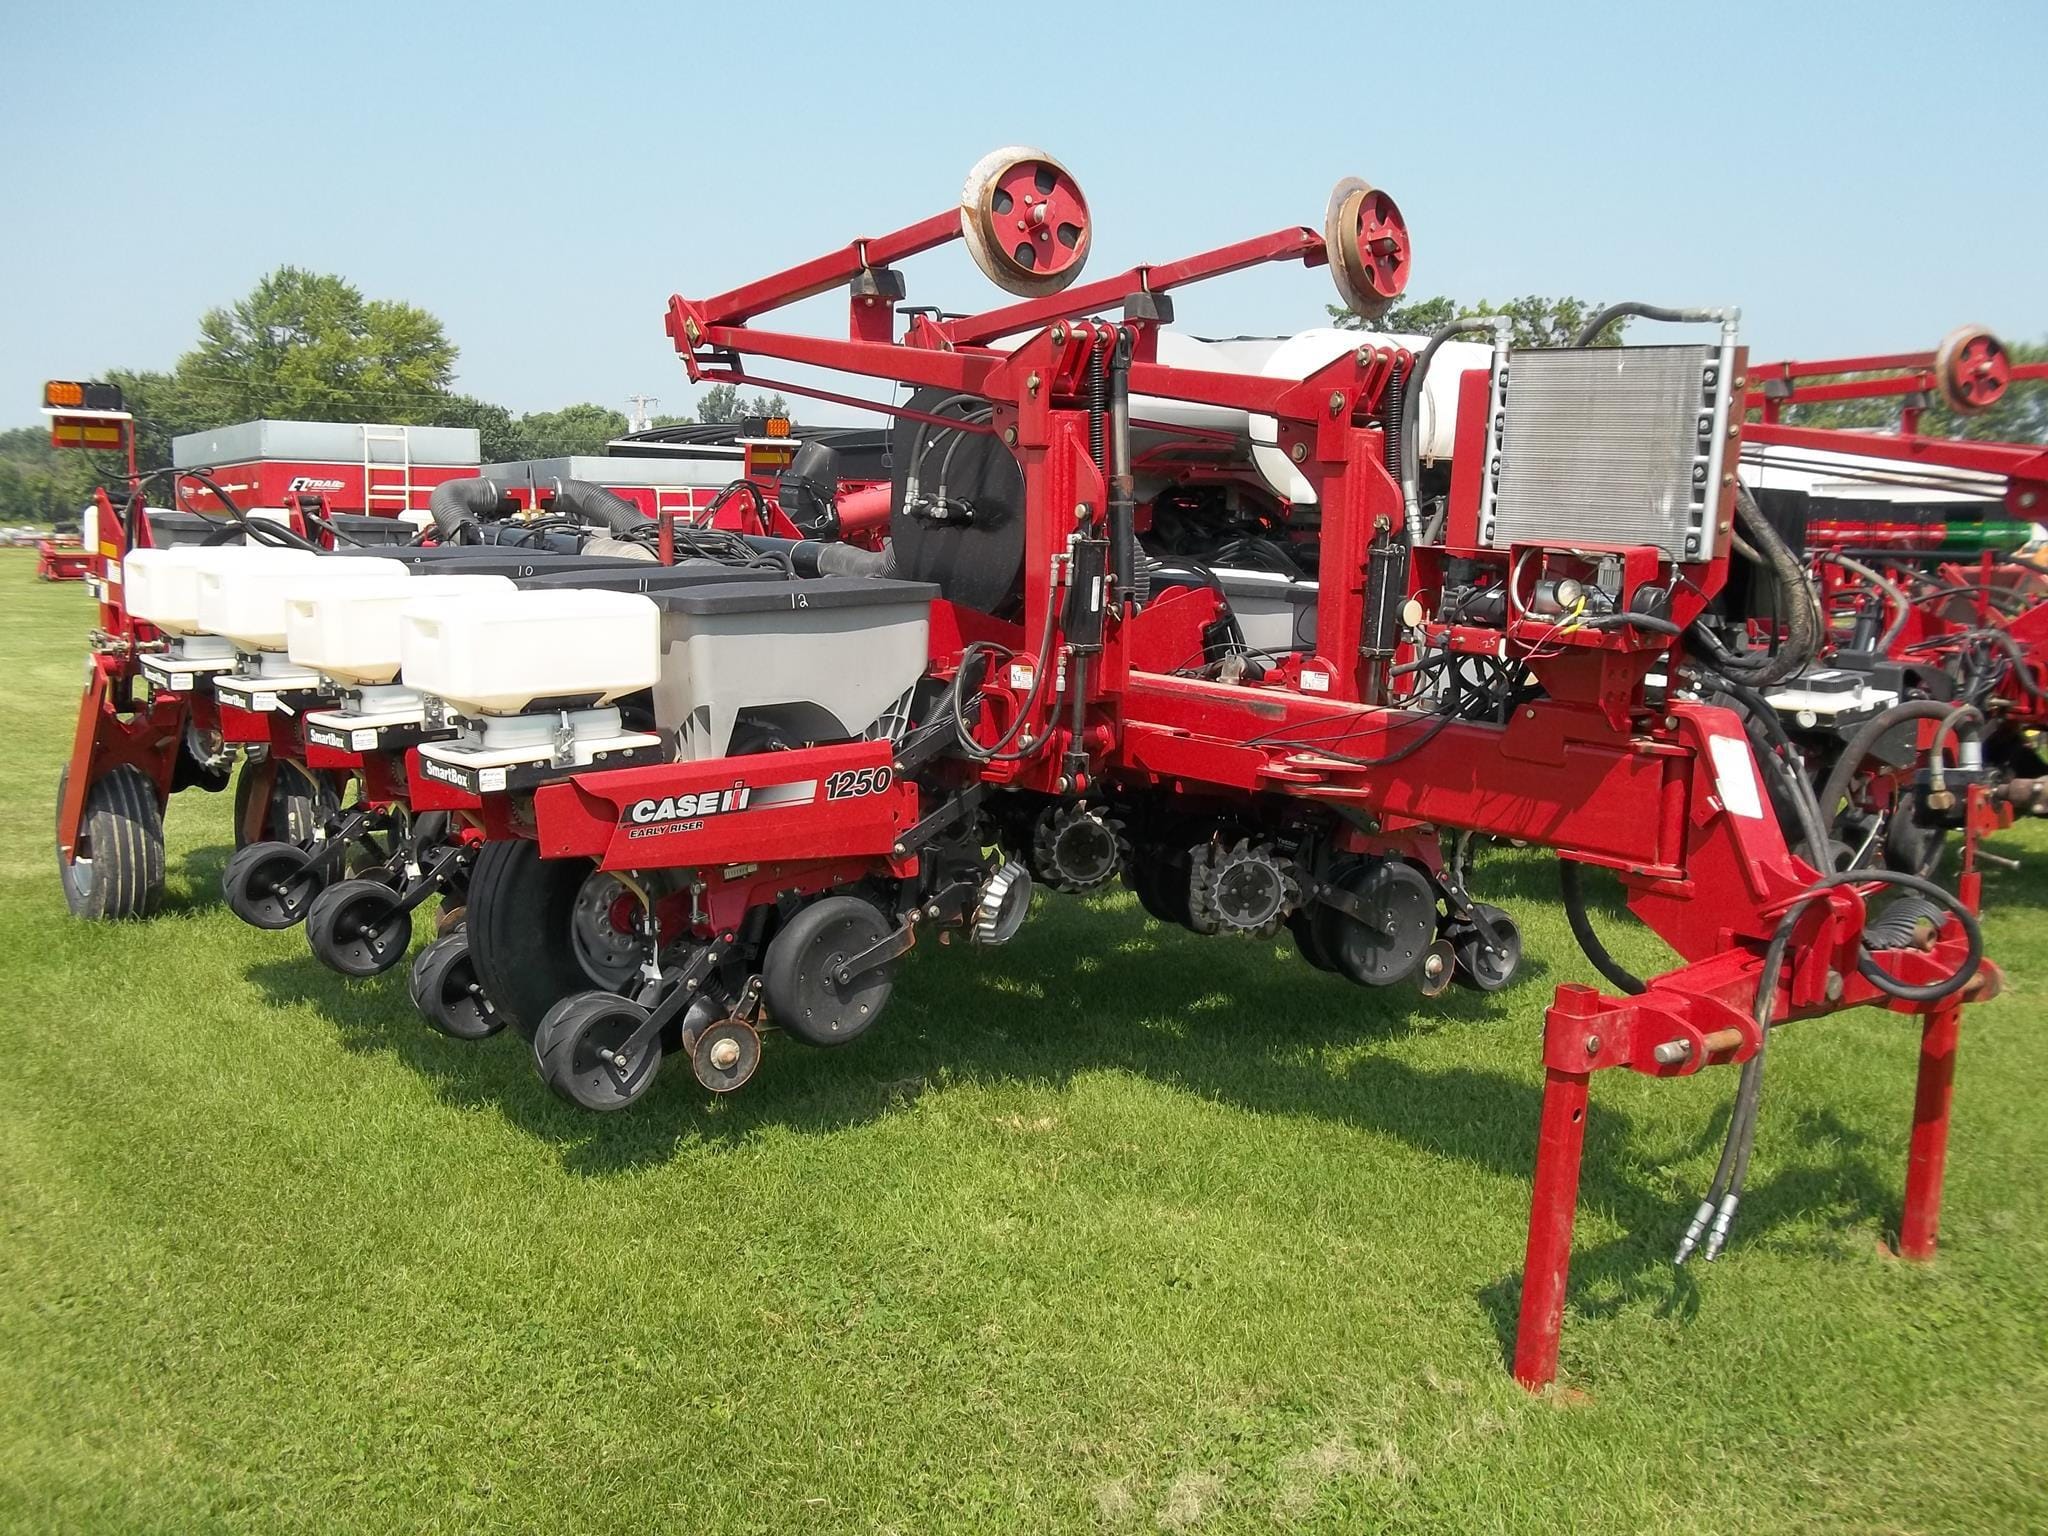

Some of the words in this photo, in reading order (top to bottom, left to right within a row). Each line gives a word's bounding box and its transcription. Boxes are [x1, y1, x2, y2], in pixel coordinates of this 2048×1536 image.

[518, 565, 534, 577] 10
[639, 578, 649, 592] 11
[791, 593, 809, 609] 12
[310, 728, 345, 748] SmartBox
[426, 760, 468, 787] SmartBox
[825, 766, 892, 801] 1250
[632, 792, 721, 823] CASE
[629, 826, 668, 839] EARLY
[669, 820, 704, 833] RISER
